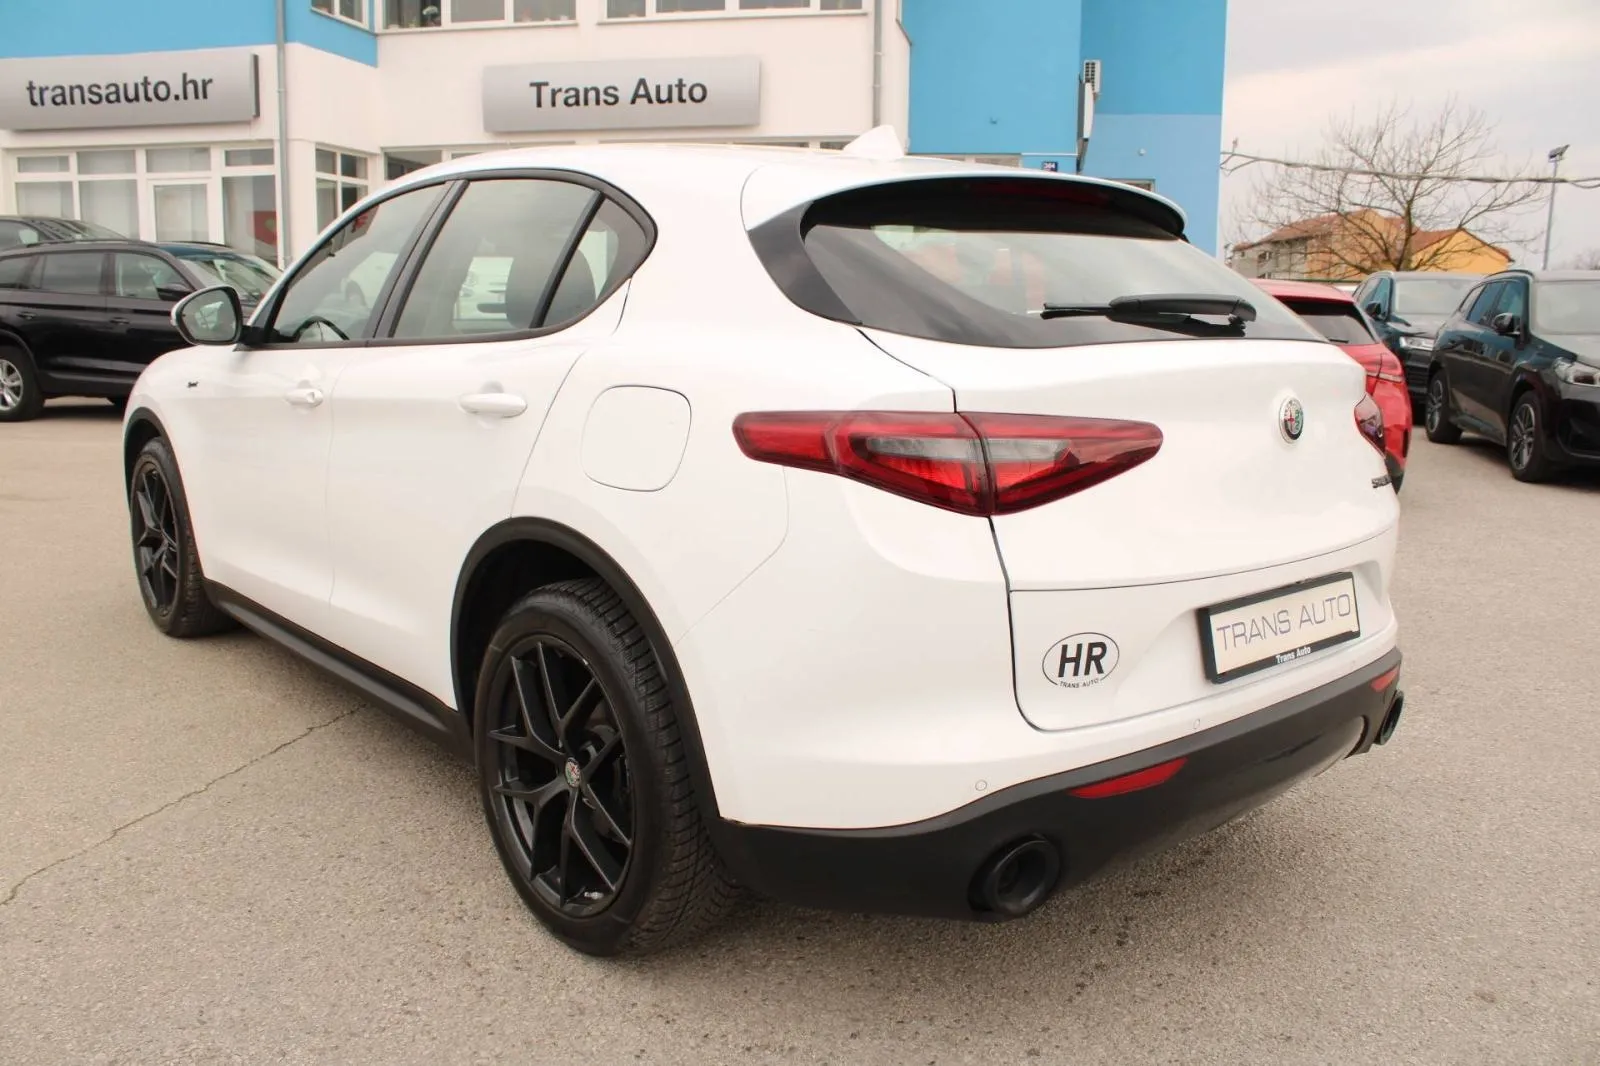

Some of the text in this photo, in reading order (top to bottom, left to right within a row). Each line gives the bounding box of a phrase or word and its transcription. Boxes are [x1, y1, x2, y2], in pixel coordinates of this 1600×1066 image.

[26, 72, 213, 107] transauto.hr
[529, 78, 708, 108] Trans Auto
[1217, 593, 1351, 651] TRANS AUTO
[1058, 641, 1107, 678] HR
[1275, 646, 1312, 664] Trans Auto
[1060, 678, 1100, 689] TRANS AUTO
